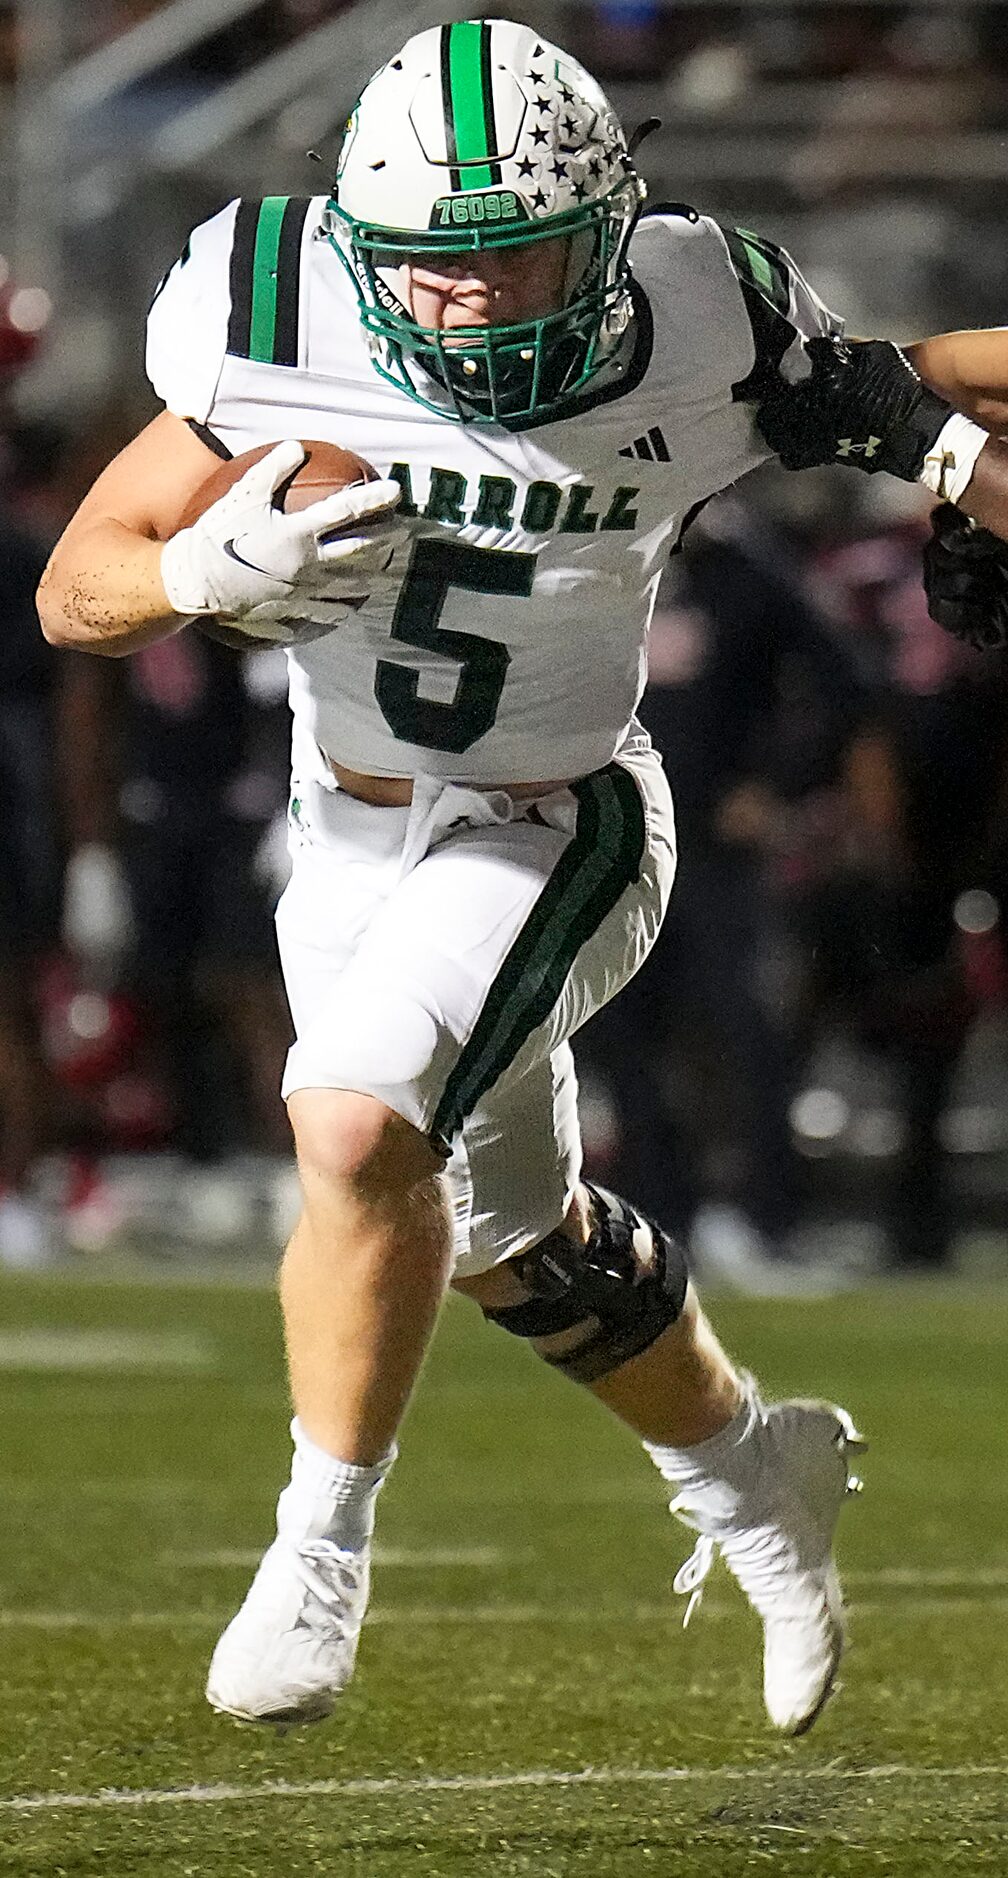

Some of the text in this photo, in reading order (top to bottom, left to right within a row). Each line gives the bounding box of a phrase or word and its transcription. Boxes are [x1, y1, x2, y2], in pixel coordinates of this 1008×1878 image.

[435, 192, 518, 225] 76092
[387, 462, 641, 534] ARROLL
[374, 537, 539, 755] 5
